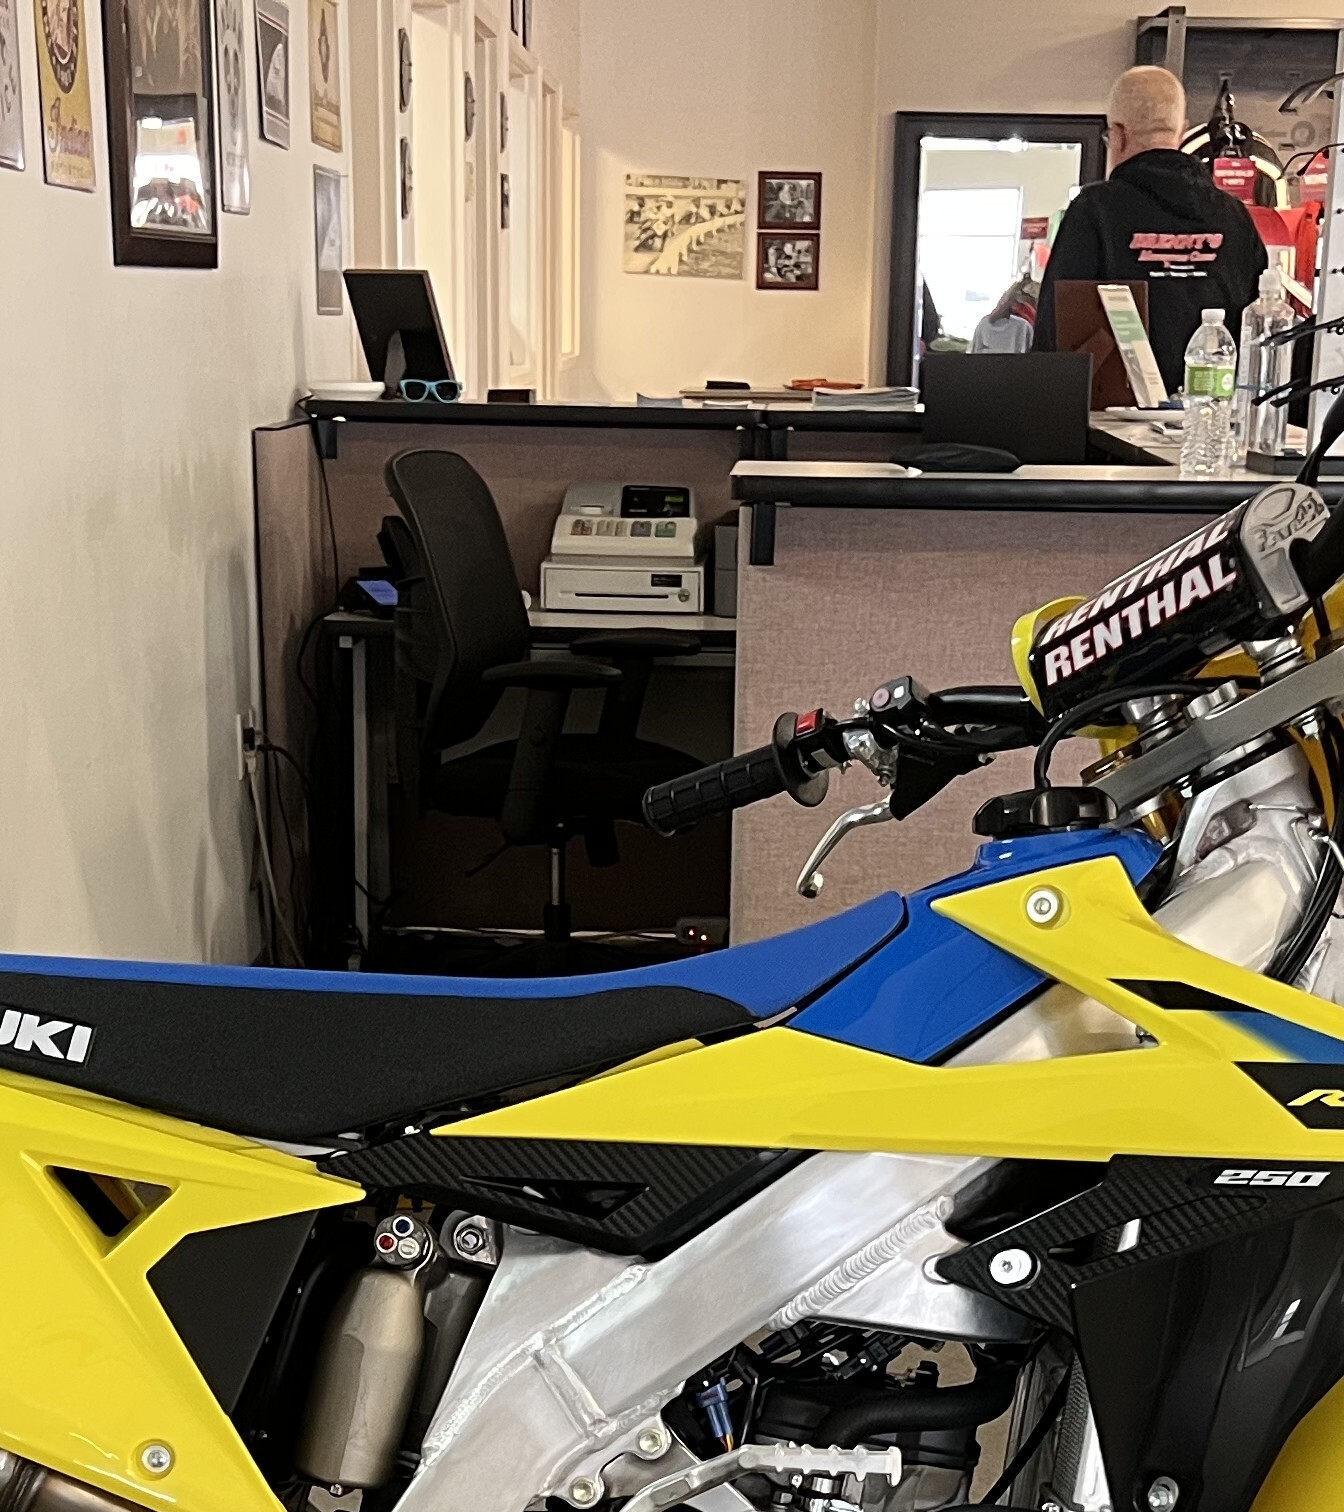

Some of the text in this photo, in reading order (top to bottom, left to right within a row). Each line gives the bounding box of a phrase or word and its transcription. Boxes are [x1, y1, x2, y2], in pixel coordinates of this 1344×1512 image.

[1040, 520, 1229, 648] RENTHAL
[1044, 552, 1237, 687] RENTHAL
[1213, 1168, 1331, 1188] 250
